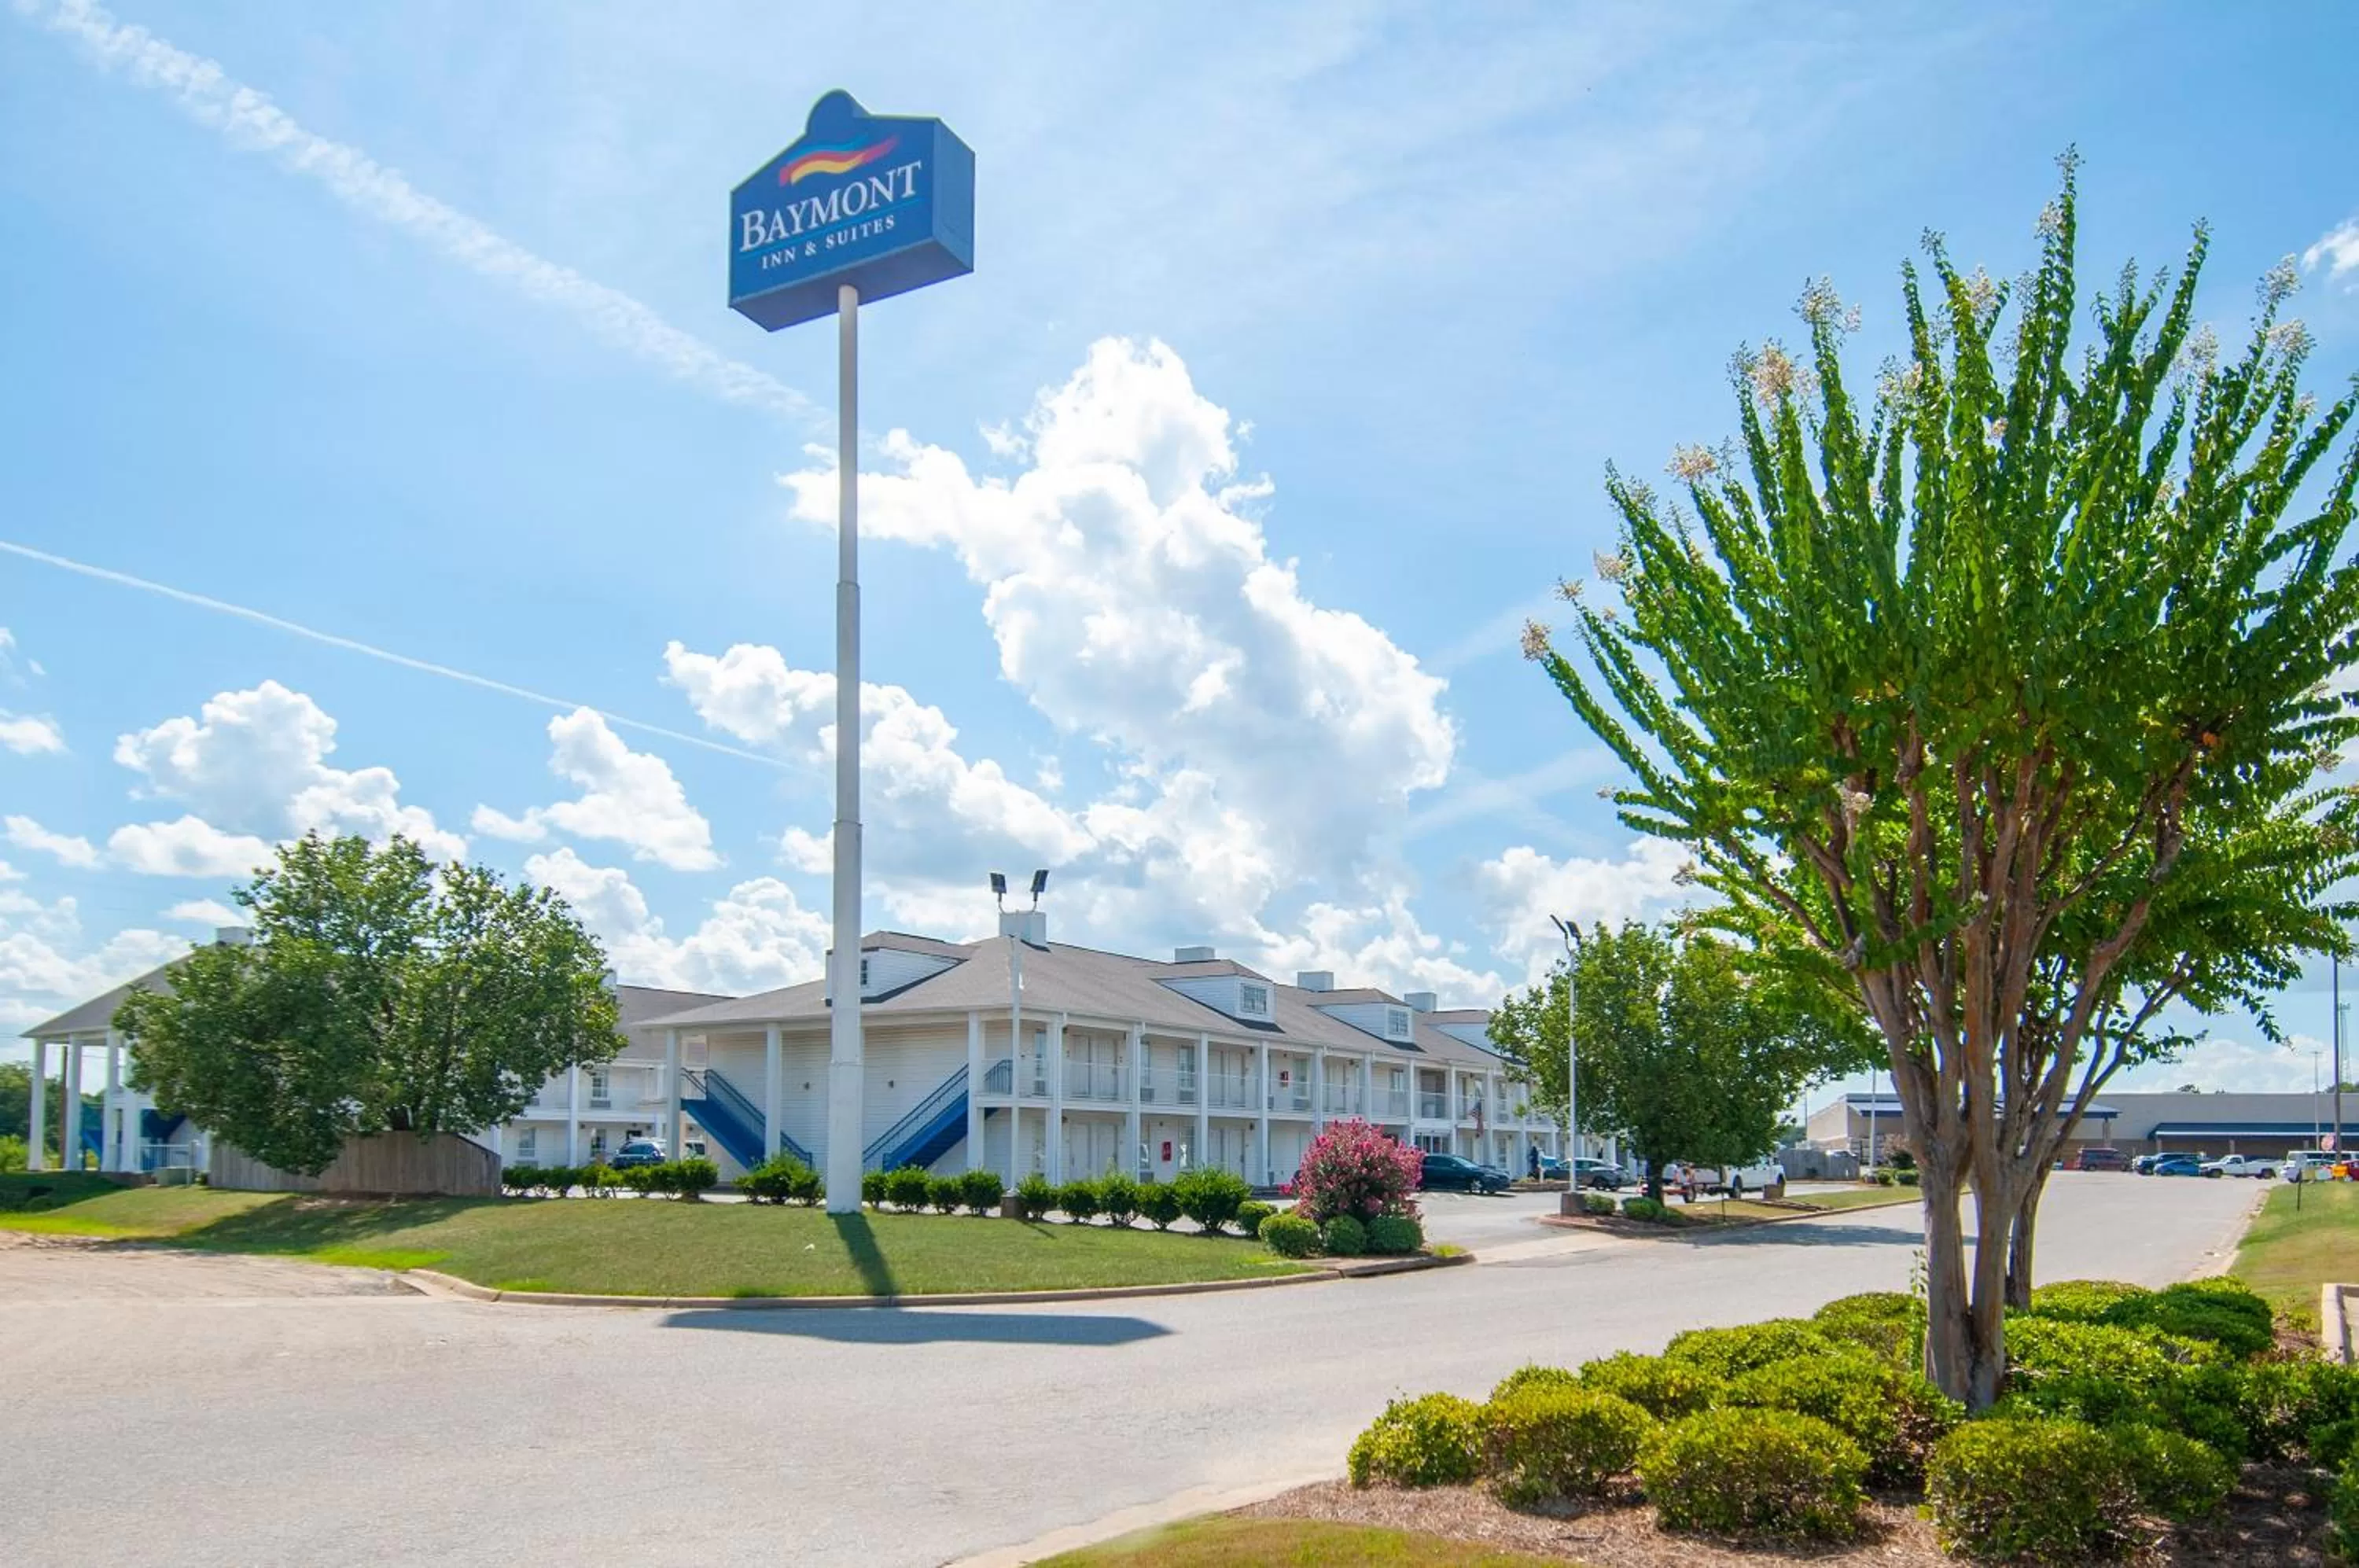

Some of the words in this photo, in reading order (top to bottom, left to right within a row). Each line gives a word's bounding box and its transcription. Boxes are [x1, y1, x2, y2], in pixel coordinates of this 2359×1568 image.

[739, 160, 922, 252] BAYMONT
[761, 247, 796, 269] INN
[804, 241, 816, 256] &
[825, 215, 895, 249] SUITES
